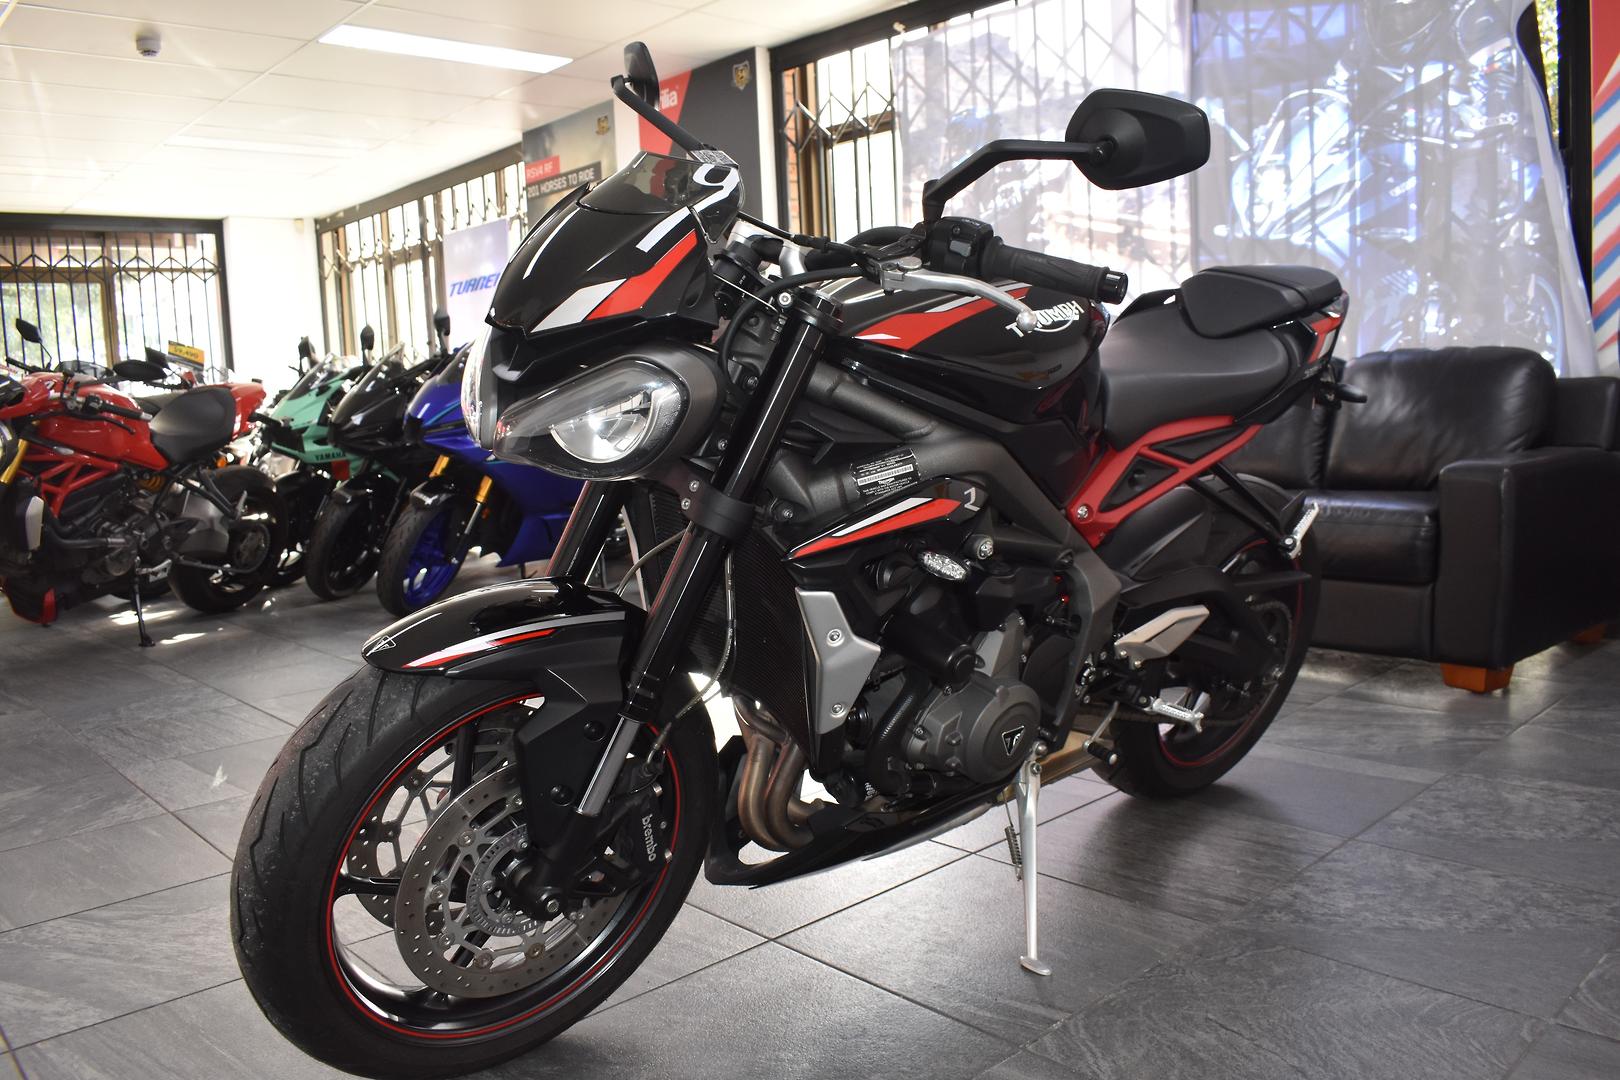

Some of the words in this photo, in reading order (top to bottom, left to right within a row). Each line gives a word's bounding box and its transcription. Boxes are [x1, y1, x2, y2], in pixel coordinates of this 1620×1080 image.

[540, 176, 567, 194] HORSES
[568, 173, 578, 186] TO
[578, 168, 595, 182] RIDE
[641, 813, 658, 862] brembo
